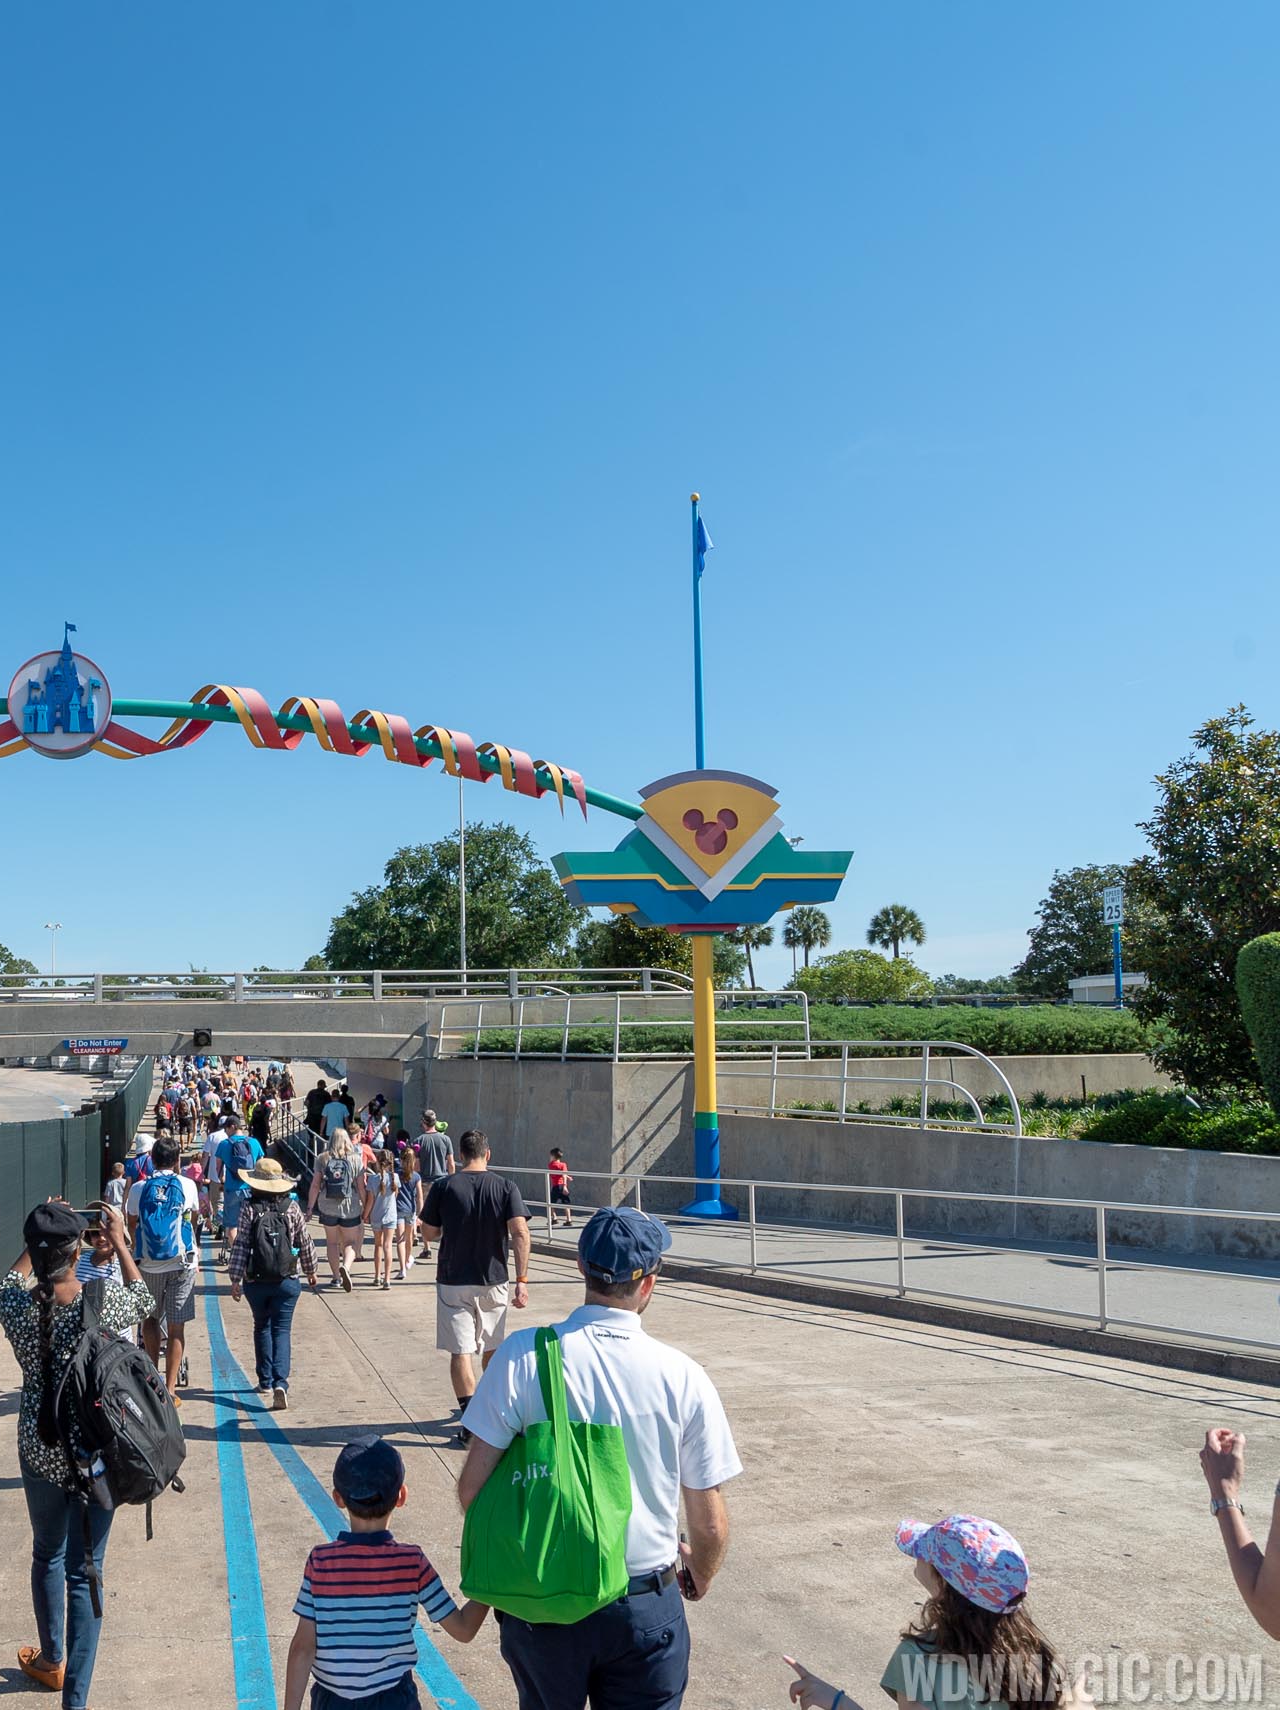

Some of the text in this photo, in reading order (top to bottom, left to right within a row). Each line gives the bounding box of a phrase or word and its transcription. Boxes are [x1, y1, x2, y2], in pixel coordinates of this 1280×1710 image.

[1105, 889, 1119, 897] SPEED
[1106, 896, 1119, 904] LIMIT
[1106, 905, 1121, 920] 25
